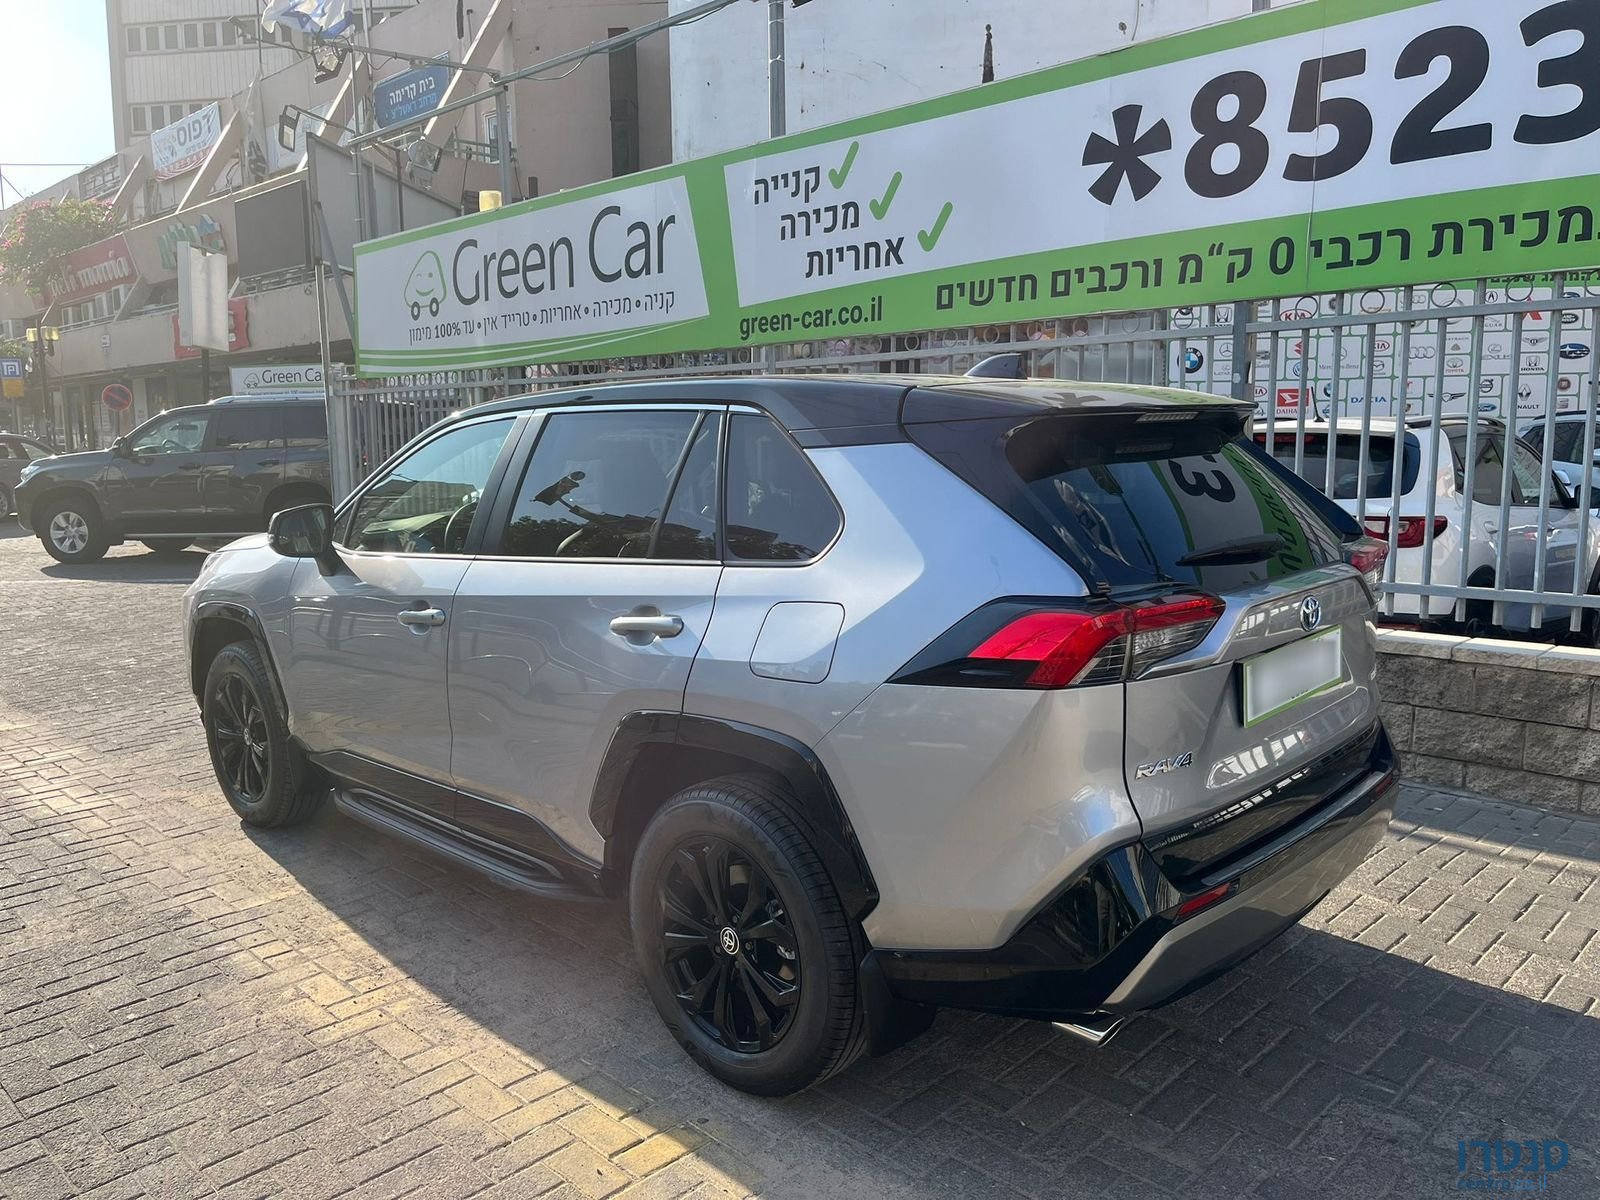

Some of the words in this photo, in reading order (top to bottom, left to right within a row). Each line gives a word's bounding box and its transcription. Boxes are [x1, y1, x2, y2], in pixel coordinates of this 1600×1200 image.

[418, 76, 436, 94] בית
[754, 166, 820, 204] קנייה
[780, 201, 860, 241] מכירה
[452, 237, 575, 306] Green
[588, 205, 676, 283] Car
[805, 236, 905, 278] אחריות
[1269, 236, 1295, 275] 0
[1309, 228, 1411, 270] רכבי
[1050, 258, 1164, 298] ורכבים
[644, 290, 676, 314] קניה
[936, 274, 1038, 311] חדשים
[501, 311, 531, 328] טרייד
[539, 304, 582, 325] אחריות
[593, 296, 632, 318] מכירה
[740, 296, 883, 340] green-car.co.il
[409, 326, 432, 345] מימון
[435, 321, 461, 339] 100%
[462, 320, 475, 335] עד
[483, 315, 498, 336] אין
[261, 369, 302, 384] Green
[1135, 751, 1193, 780] RAV4
